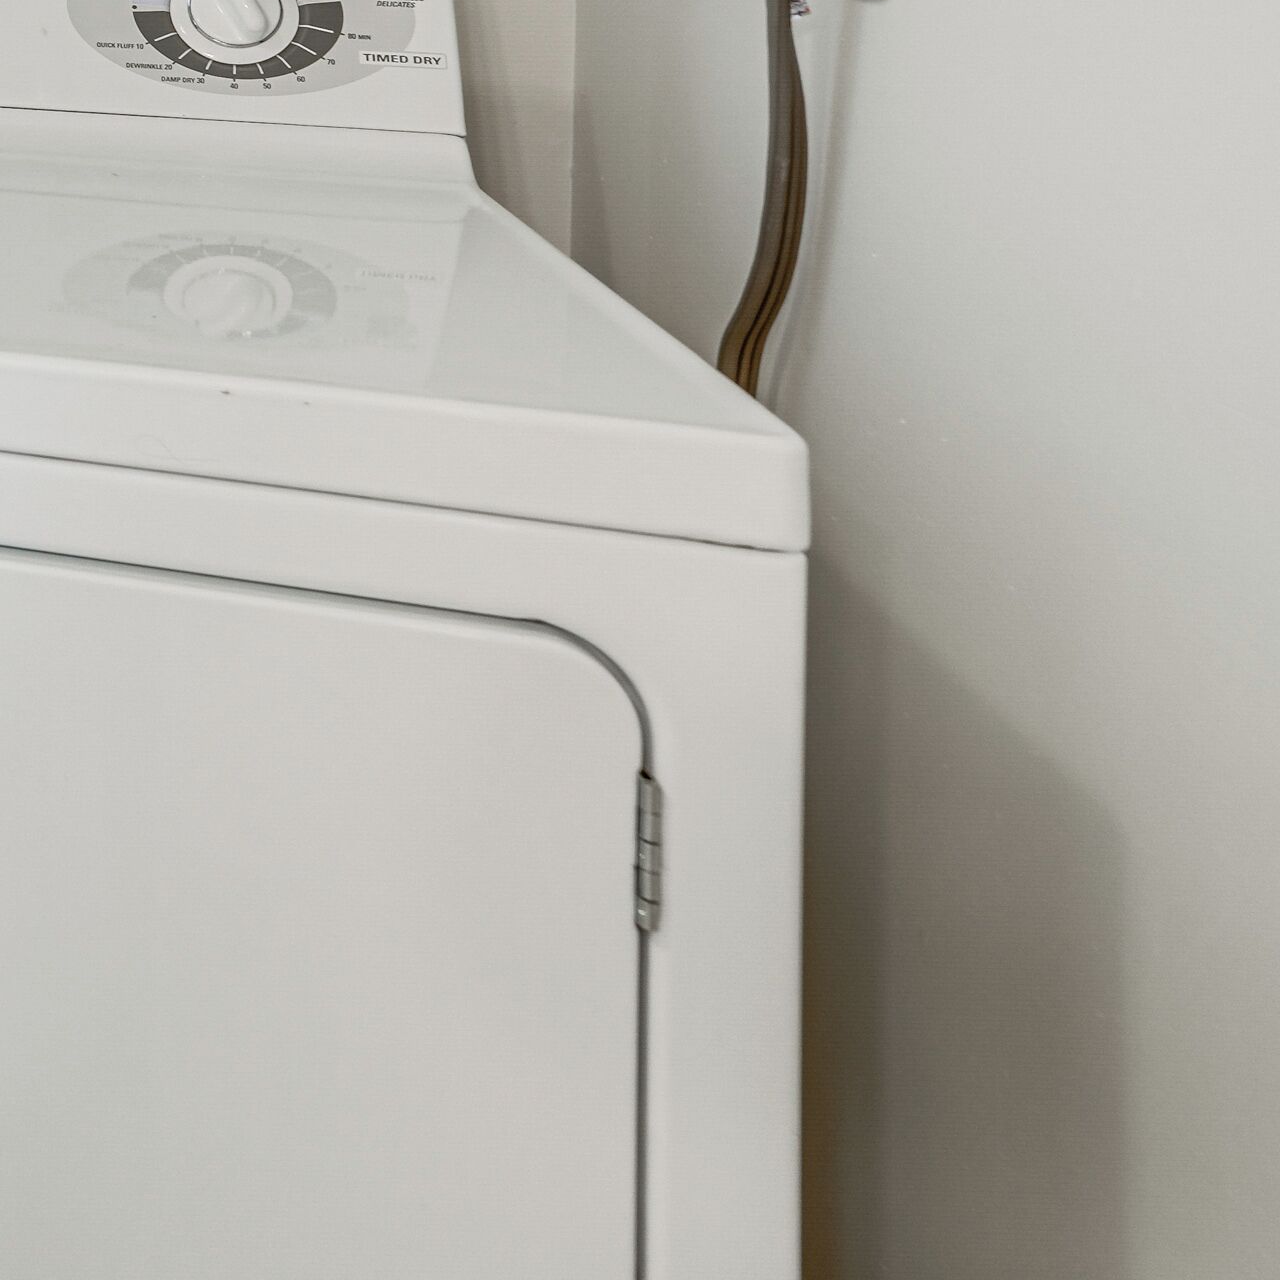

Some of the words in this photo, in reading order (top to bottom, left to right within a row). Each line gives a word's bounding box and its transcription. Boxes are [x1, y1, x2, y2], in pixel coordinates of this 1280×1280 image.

[363, 53, 408, 64] TIMED
[413, 55, 441, 65] DRY
[125, 62, 162, 70] DEWRINKLE
